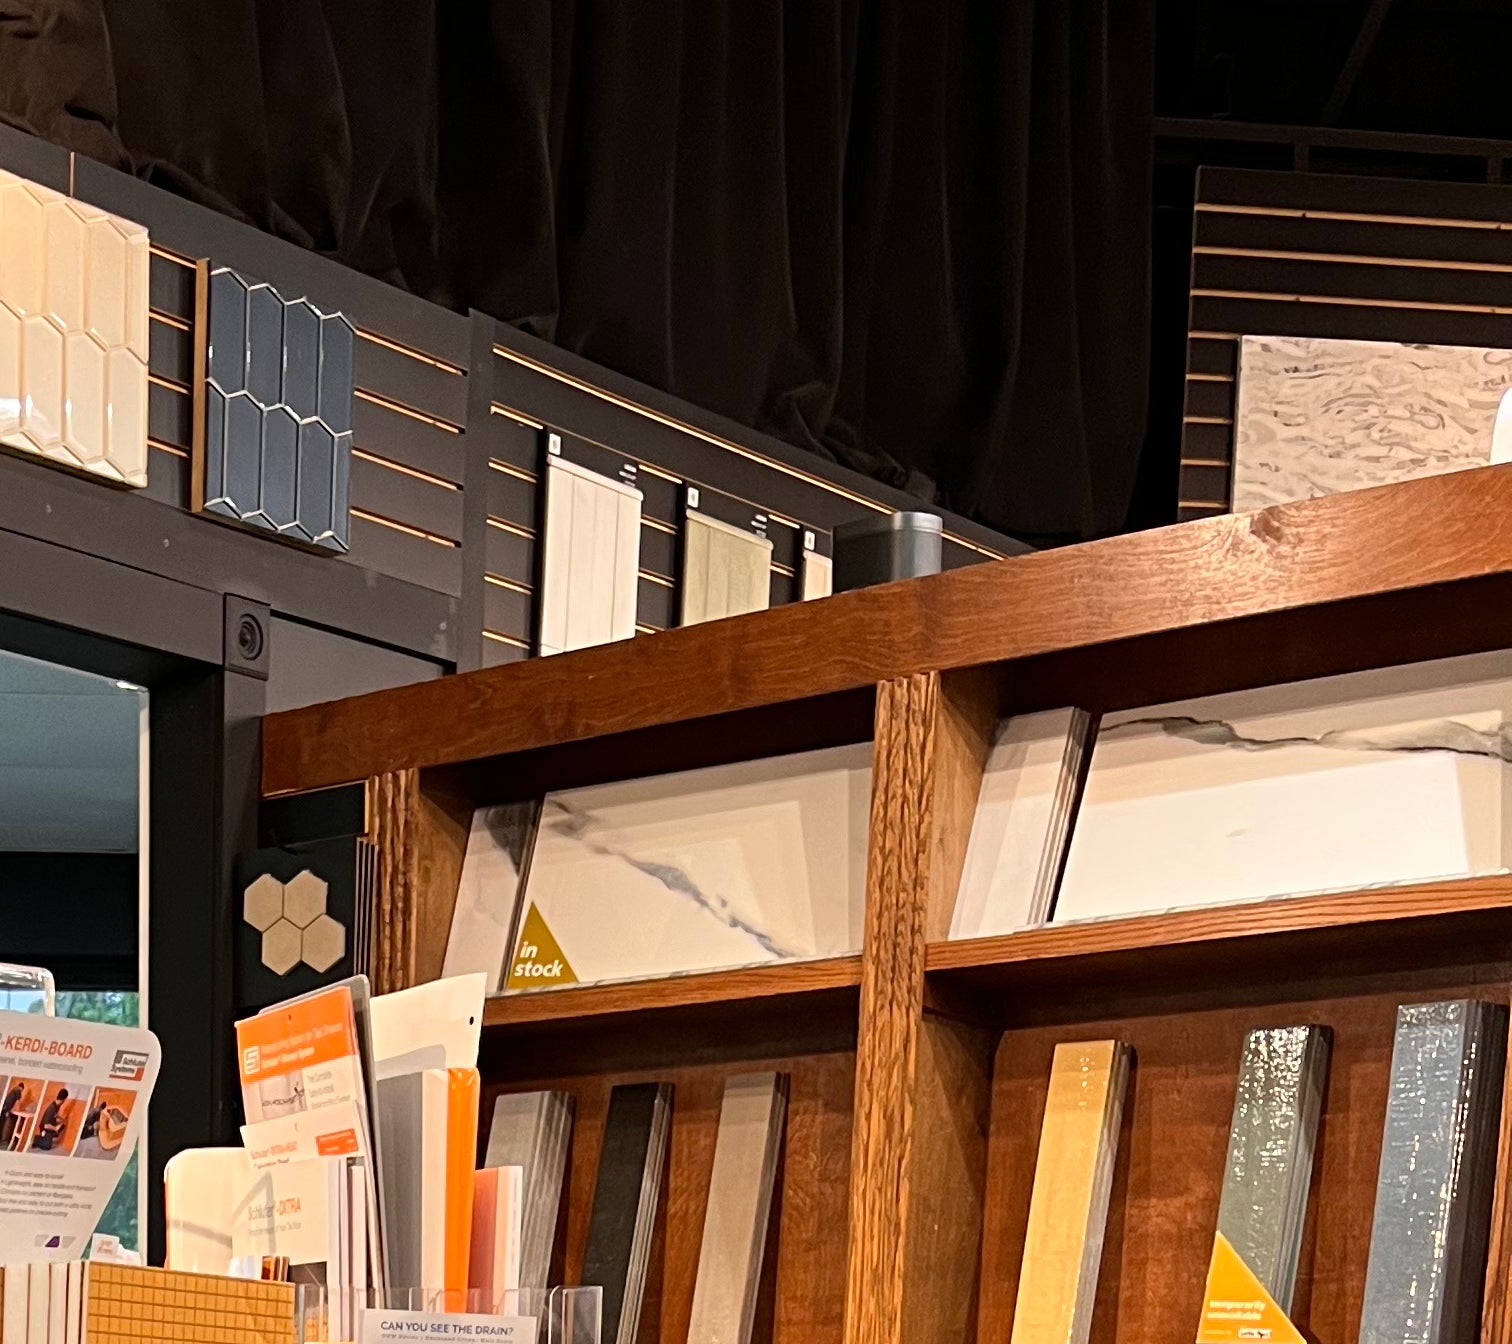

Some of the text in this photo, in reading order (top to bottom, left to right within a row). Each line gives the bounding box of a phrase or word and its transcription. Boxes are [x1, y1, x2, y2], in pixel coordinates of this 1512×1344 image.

[520, 941, 538, 959] in
[514, 959, 564, 977] stock
[380, 1321, 514, 1336] CAN YOU SEE THE DRAIN?
